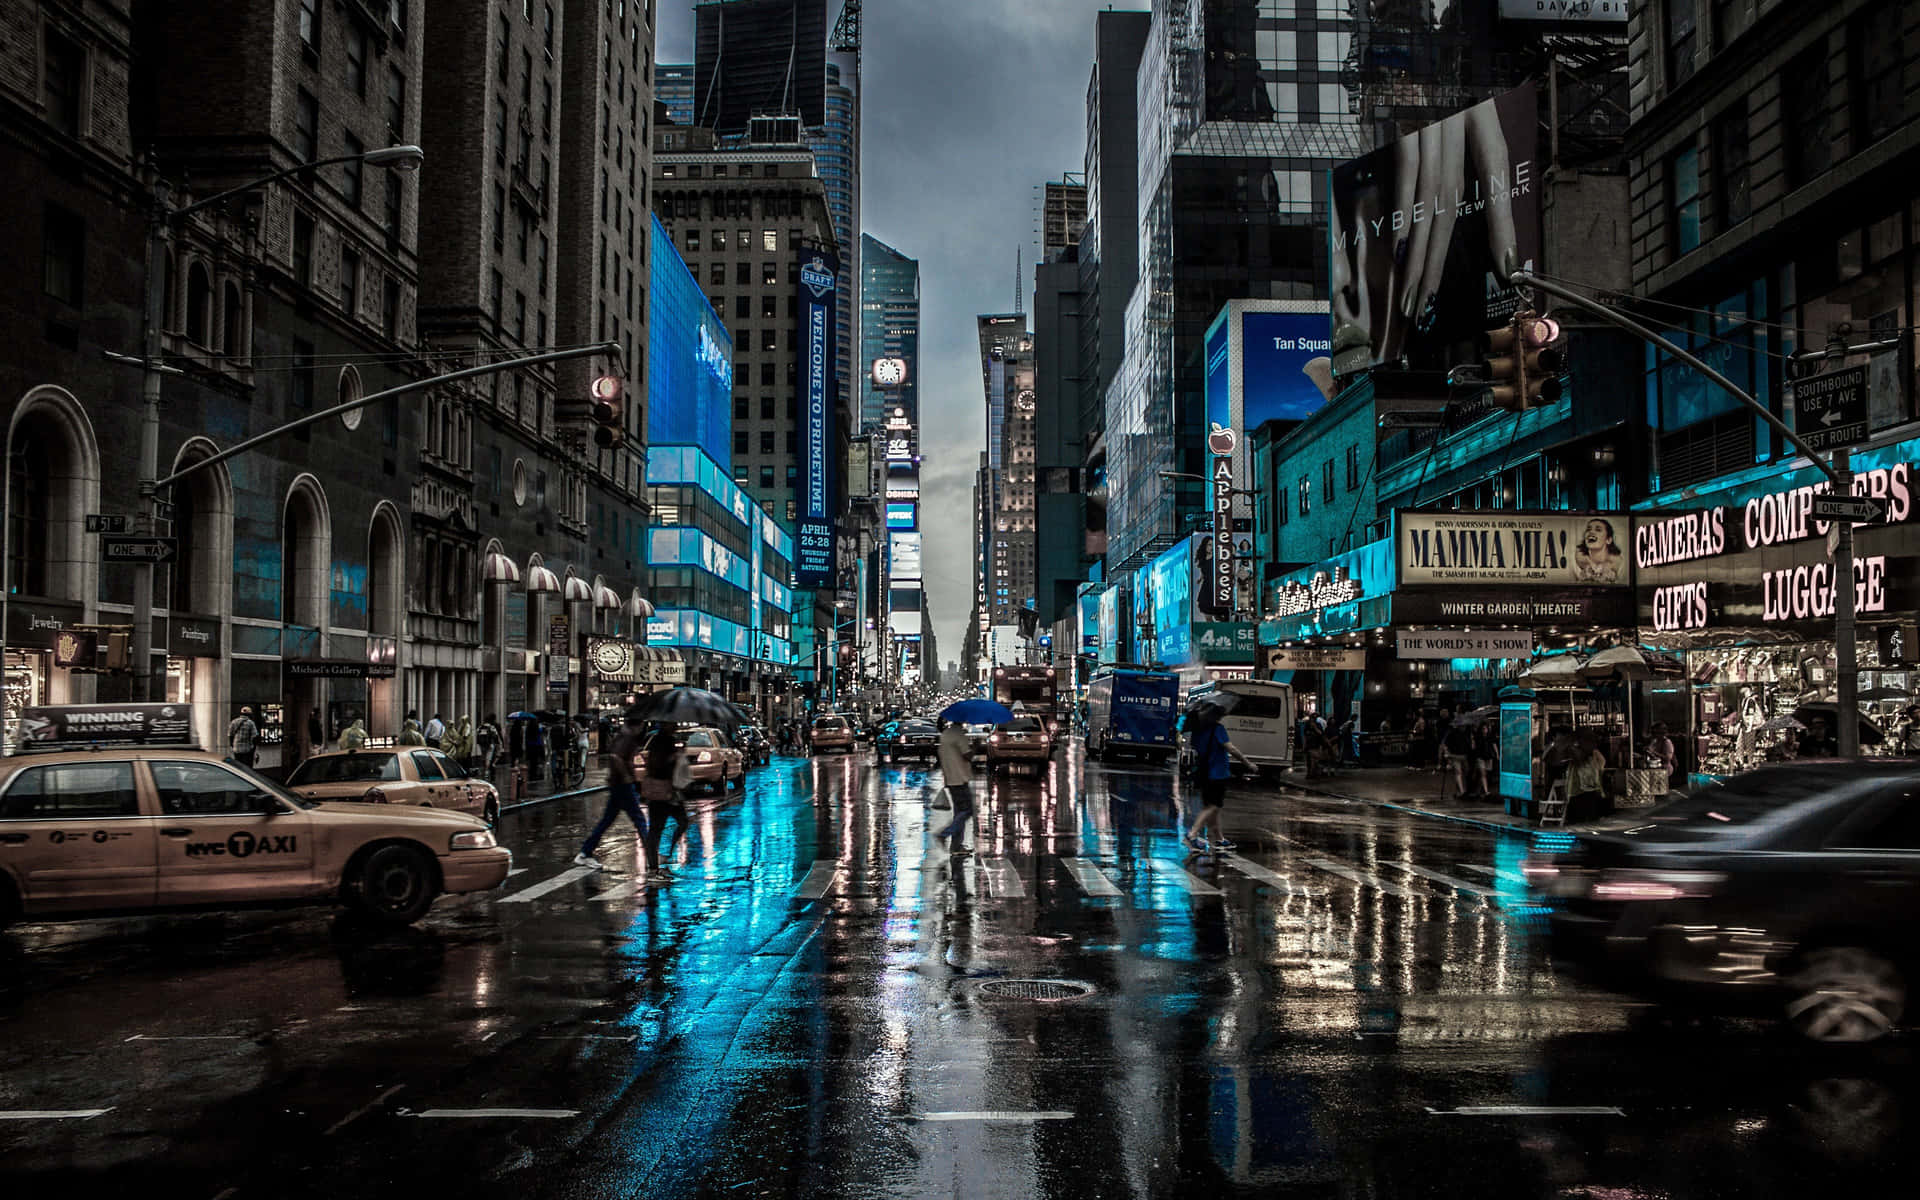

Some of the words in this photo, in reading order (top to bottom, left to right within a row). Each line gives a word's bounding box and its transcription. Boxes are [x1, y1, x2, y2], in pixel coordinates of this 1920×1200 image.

[1537, 1, 1588, 11] DAVID
[1331, 160, 1531, 251] MAYBELLINE
[1456, 199, 1486, 217] NEW
[1490, 184, 1531, 206] YORK
[803, 270, 832, 287] DRAFT
[811, 309, 824, 389] WELCOME
[1274, 337, 1295, 350] Tan
[1797, 371, 1862, 398] SOUTHBOUND
[811, 393, 823, 414] TO
[1803, 396, 1822, 413] USE
[1826, 393, 1832, 407] 7
[1839, 387, 1857, 405] AVE
[1829, 424, 1863, 445] ROUTE
[811, 419, 824, 512] PRIMETIME
[1822, 503, 1843, 514] ONE
[1853, 505, 1874, 516] WAY
[88, 517, 98, 531] W
[101, 516, 111, 531] 51
[800, 524, 830, 535] APRIL
[1455, 520, 1490, 529] ANDERSSON
[801, 535, 830, 547] 26-28
[1635, 506, 1725, 569] CAMERAS
[113, 544, 135, 555] ONE
[144, 545, 166, 556] WAY
[801, 549, 830, 557] THURSDAY
[1410, 529, 1506, 568] MAMMA
[1512, 530, 1567, 569] MIA!
[801, 563, 830, 572] SATURDAY
[1432, 570, 1443, 578] THE
[1445, 570, 1466, 578] SMASH
[1441, 602, 1483, 616] WINTER
[1487, 602, 1530, 616] GARDEN
[1533, 602, 1581, 616] THEATRE
[1653, 581, 1708, 631] GIFTS
[26, 614, 64, 631] Jewelry
[1200, 629, 1215, 646] 4
[1403, 638, 1422, 649] THE
[1426, 638, 1473, 649] WORLD'S
[1476, 640, 1488, 649] #1
[1492, 639, 1528, 650] SHOW!
[291, 664, 329, 674] Michael's
[331, 664, 361, 675] Gallery
[1120, 696, 1159, 704] UNITED
[66, 712, 144, 724] WINNING
[186, 843, 225, 855] NYC
[228, 831, 297, 857] TAXI
